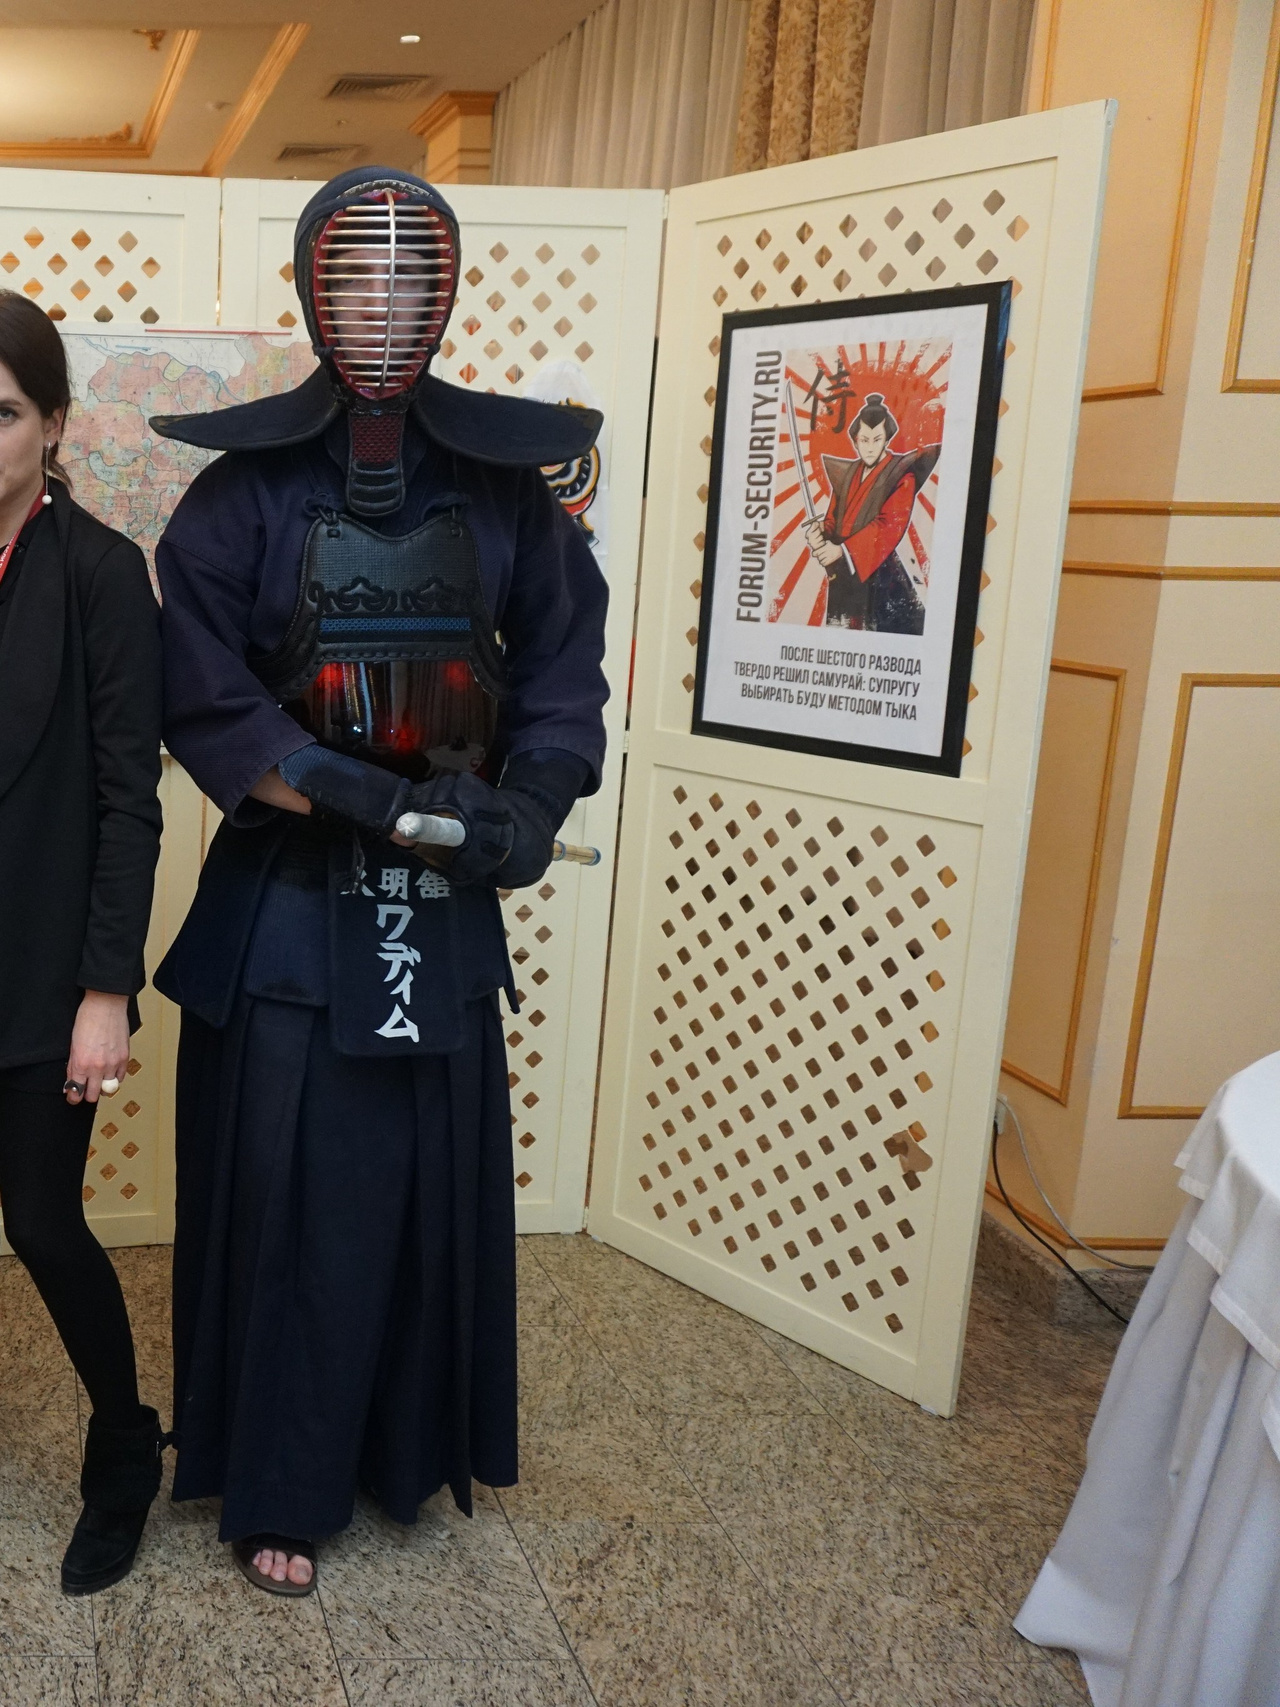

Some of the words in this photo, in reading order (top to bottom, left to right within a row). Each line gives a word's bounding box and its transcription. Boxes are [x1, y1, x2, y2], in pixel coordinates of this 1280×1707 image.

[803, 359, 857, 434] 侍
[736, 350, 783, 623] FORUM-SECURITY.RU
[734, 661, 771, 681] ТВЕРДО
[773, 666, 810, 685] РЕШИЛ
[812, 670, 867, 692] САМУРАЙ:
[868, 676, 921, 698] СУПРУГУ
[780, 645, 815, 663] ПОСЛЕ
[816, 648, 866, 669] ШЕСТОГО
[868, 654, 922, 676] РАЗВОДА
[741, 682, 795, 704] ВЫБИРАТЬ
[796, 690, 827, 709] БУДУ
[827, 693, 882, 716] МЕТОДОМ
[885, 700, 918, 721] ТЫКА
[373, 904, 422, 1043] ワディム
